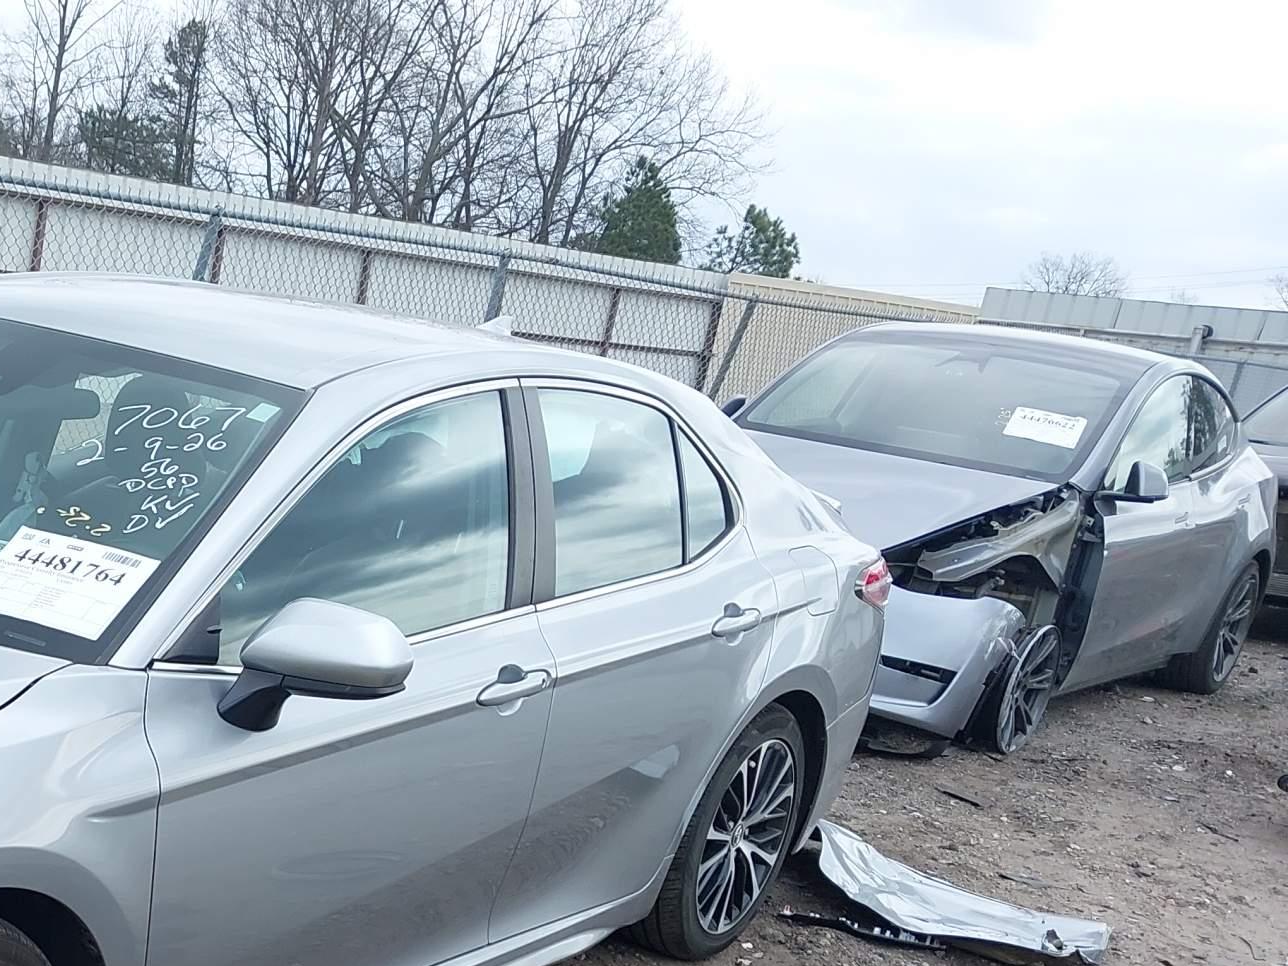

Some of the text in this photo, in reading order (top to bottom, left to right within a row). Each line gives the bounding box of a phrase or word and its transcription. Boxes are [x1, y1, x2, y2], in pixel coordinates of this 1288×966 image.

[114, 404, 246, 435] 7067
[140, 458, 180, 479] 56
[14, 549, 127, 587] 44481764
